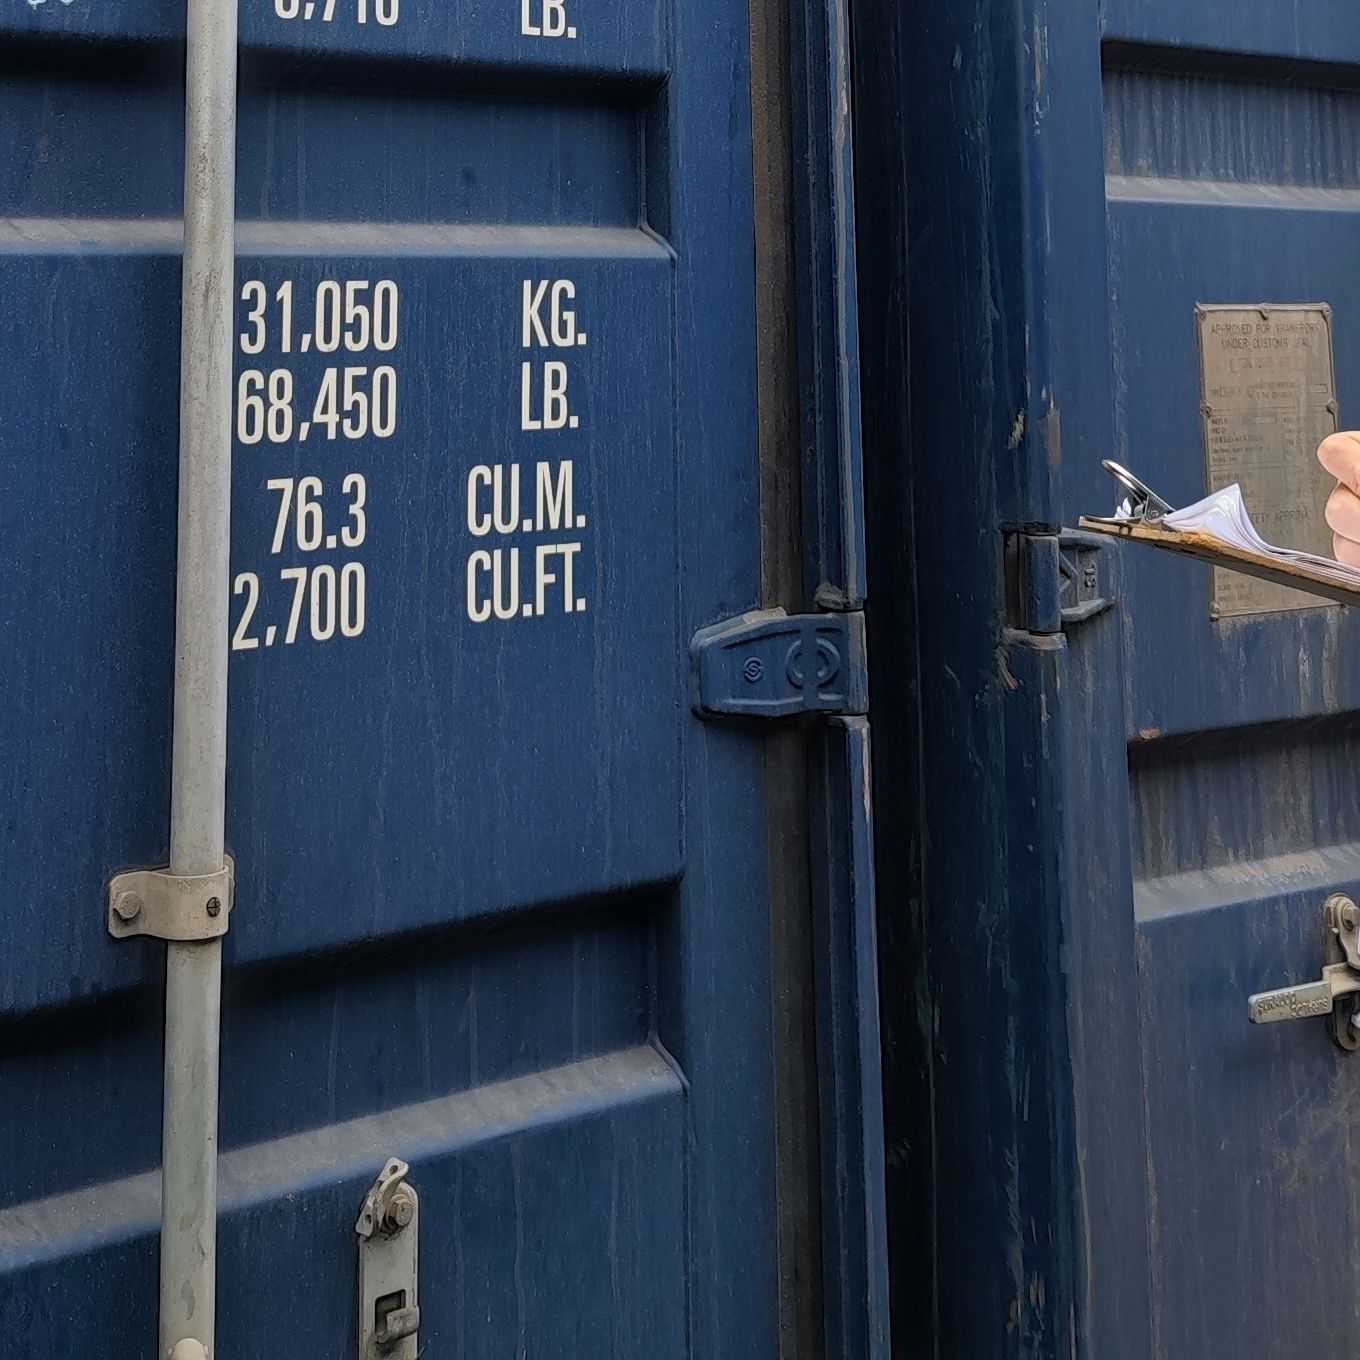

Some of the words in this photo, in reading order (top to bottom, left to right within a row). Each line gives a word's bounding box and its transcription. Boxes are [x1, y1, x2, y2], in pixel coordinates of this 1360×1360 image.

[239, 279, 399, 355] 31,050
[521, 279, 587, 348] KG.
[237, 365, 398, 445] 68,450
[521, 360, 579, 431] LB.
[266, 473, 367, 554] 76.3
[232, 562, 366, 651] 2,700
